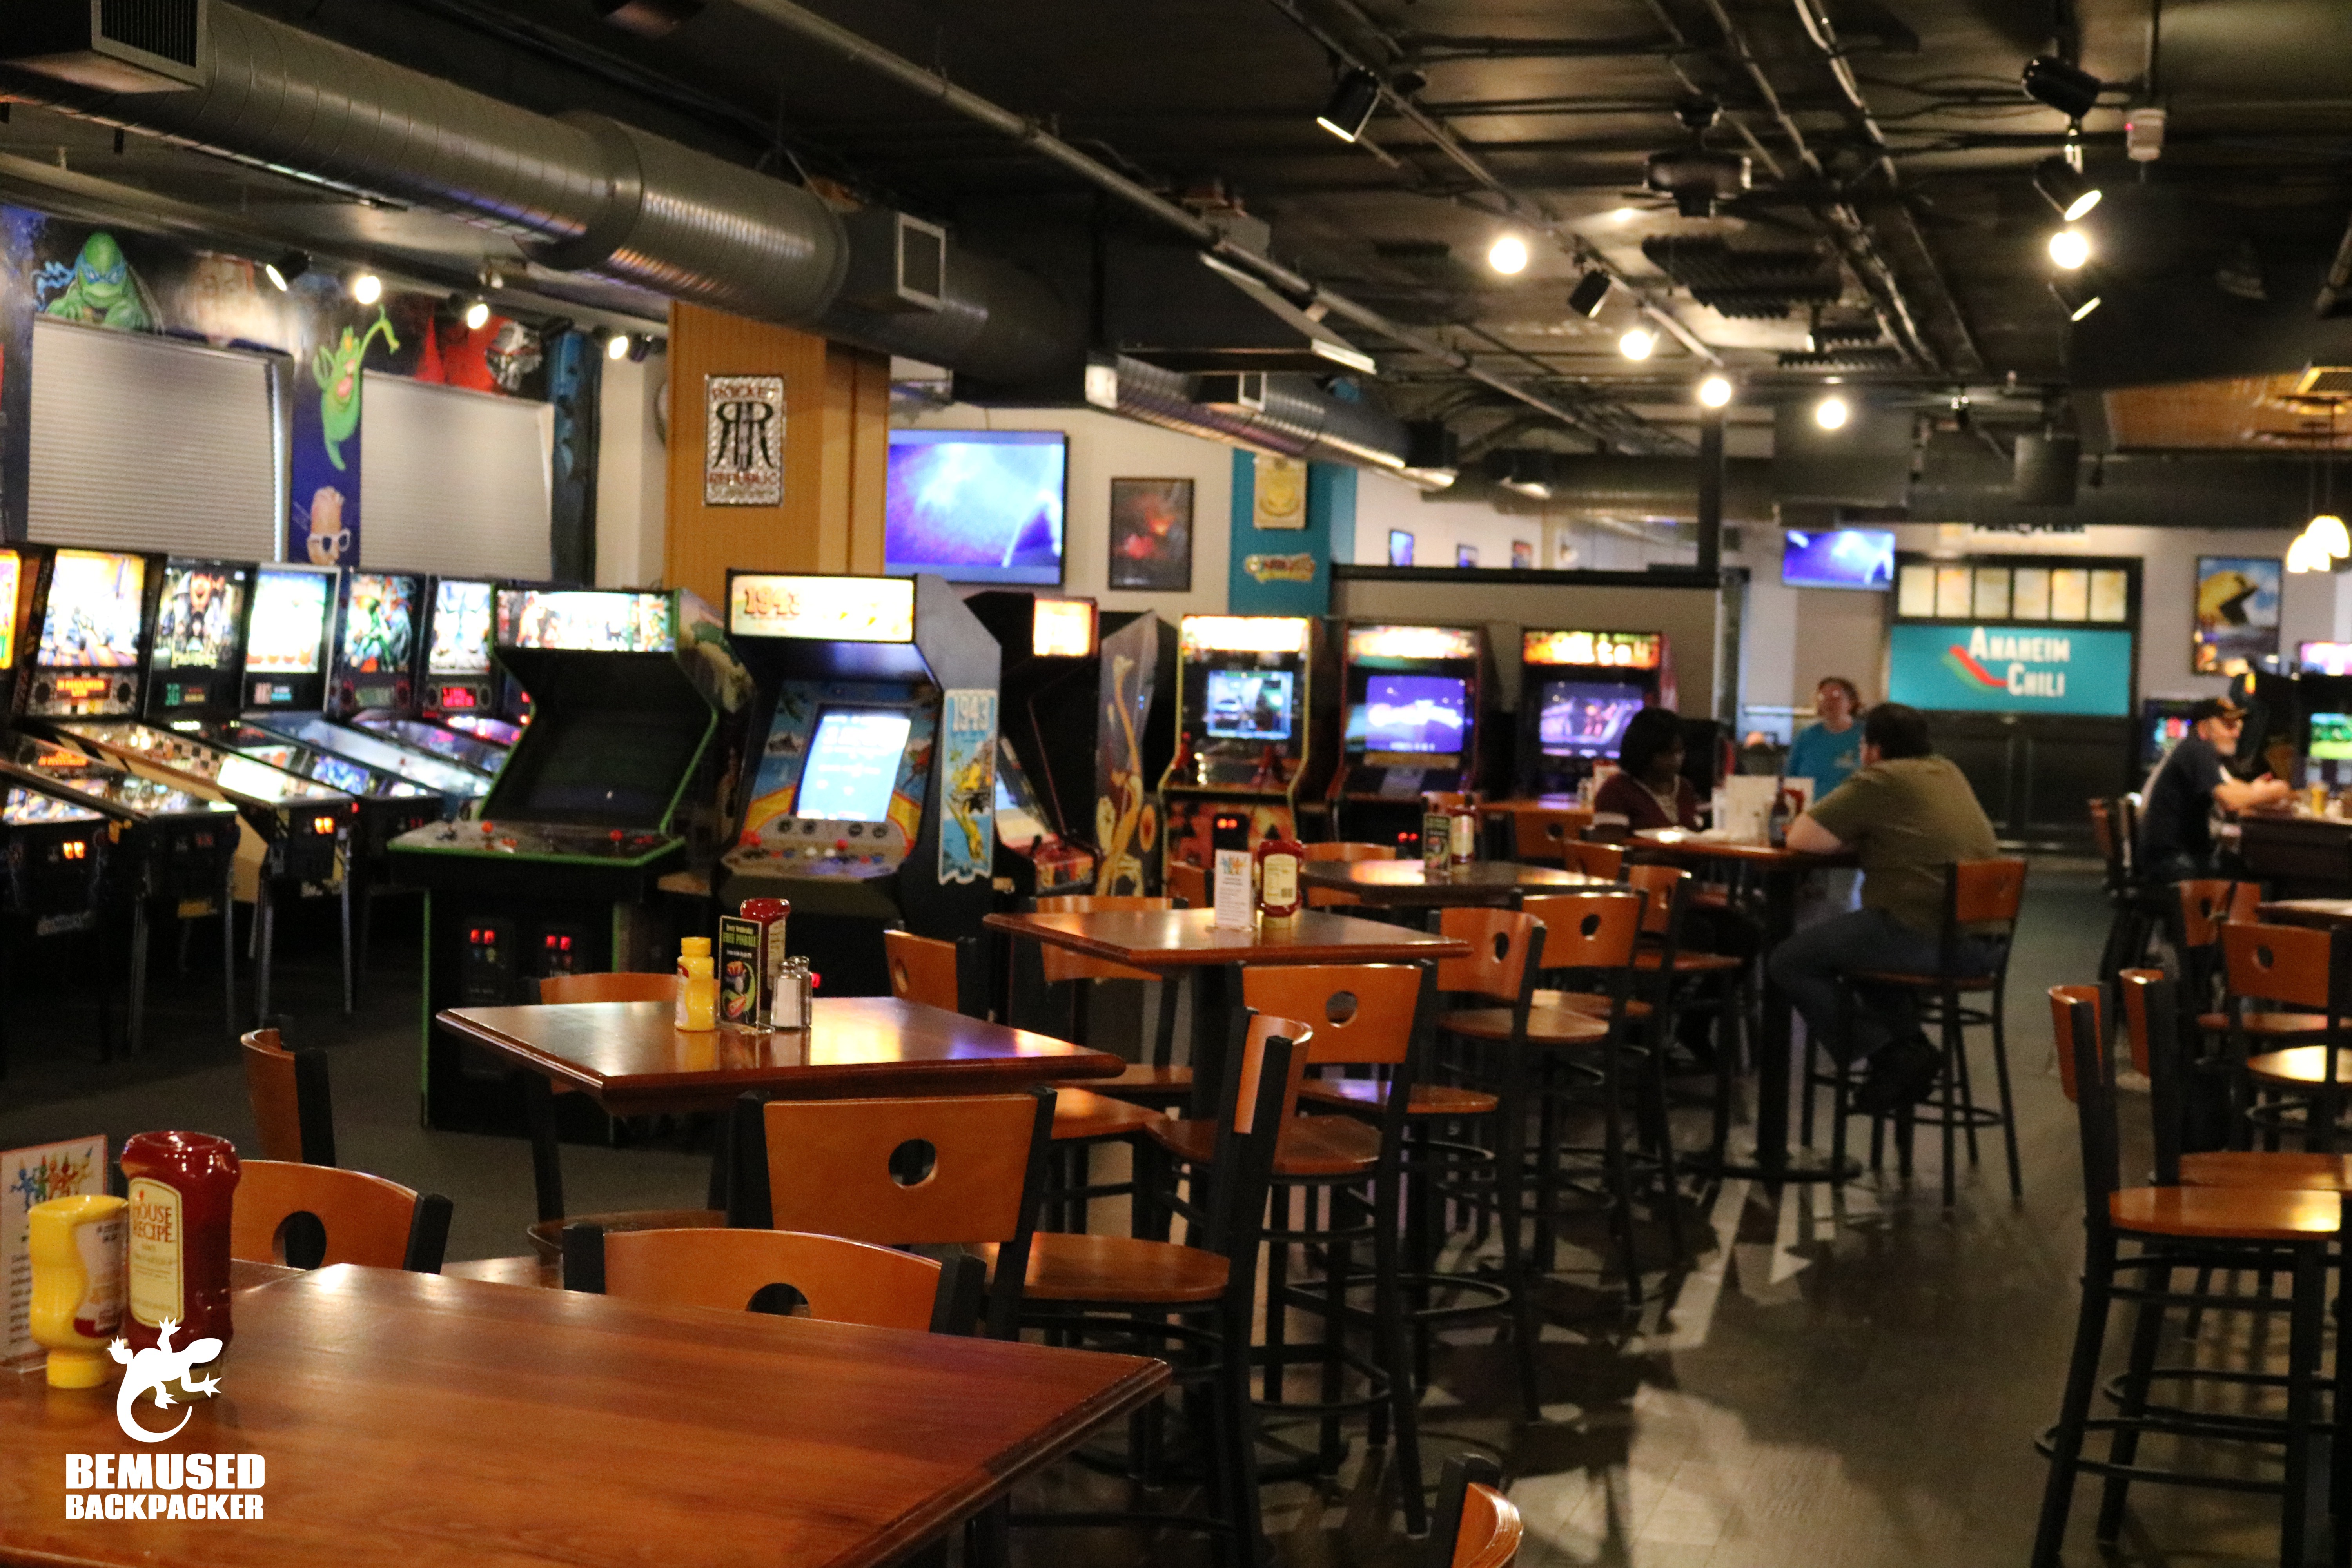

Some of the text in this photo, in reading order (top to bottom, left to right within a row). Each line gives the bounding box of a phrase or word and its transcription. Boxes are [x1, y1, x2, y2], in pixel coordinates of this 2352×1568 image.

[1969, 626, 2070, 662] ANAHEIM
[2007, 662, 2065, 697] CHILI
[132, 1201, 172, 1224] HOUSE
[132, 1222, 174, 1243] RECIPE
